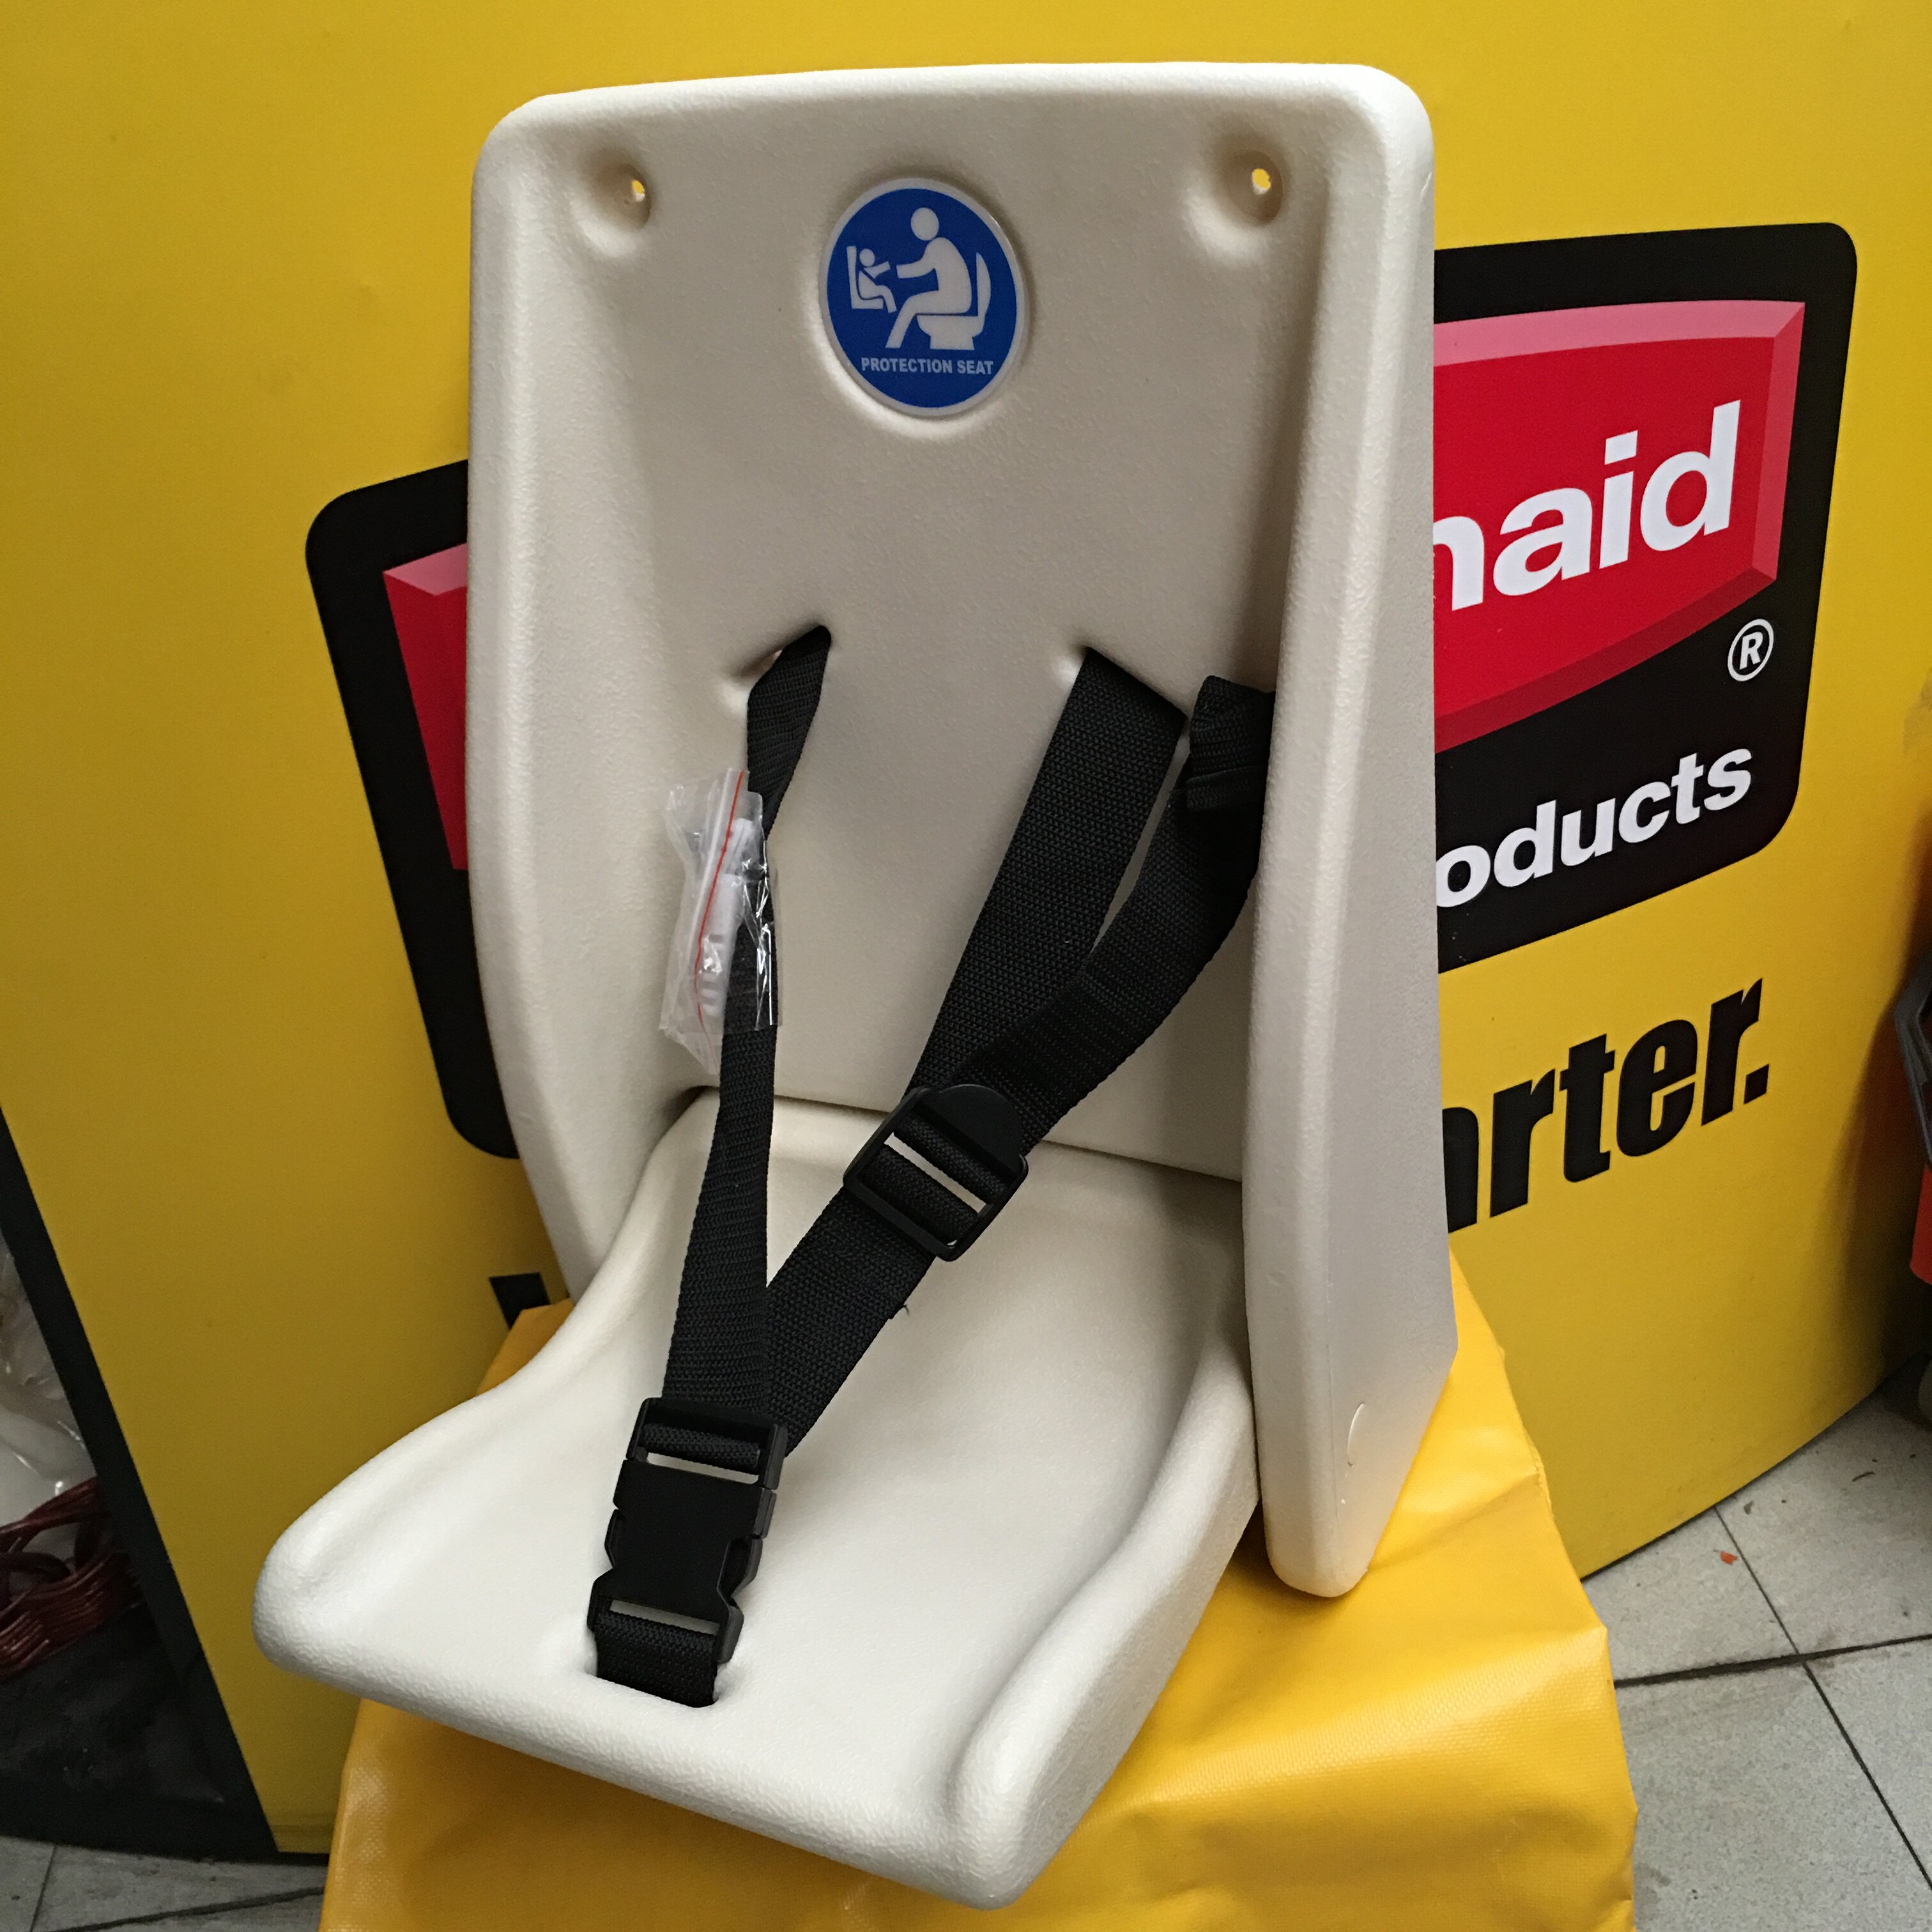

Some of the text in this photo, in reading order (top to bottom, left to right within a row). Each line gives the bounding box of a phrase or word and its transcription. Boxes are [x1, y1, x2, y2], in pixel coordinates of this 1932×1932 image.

[861, 357, 993, 375] PROTECTION SEAT
[1436, 748, 1752, 907] oducts
